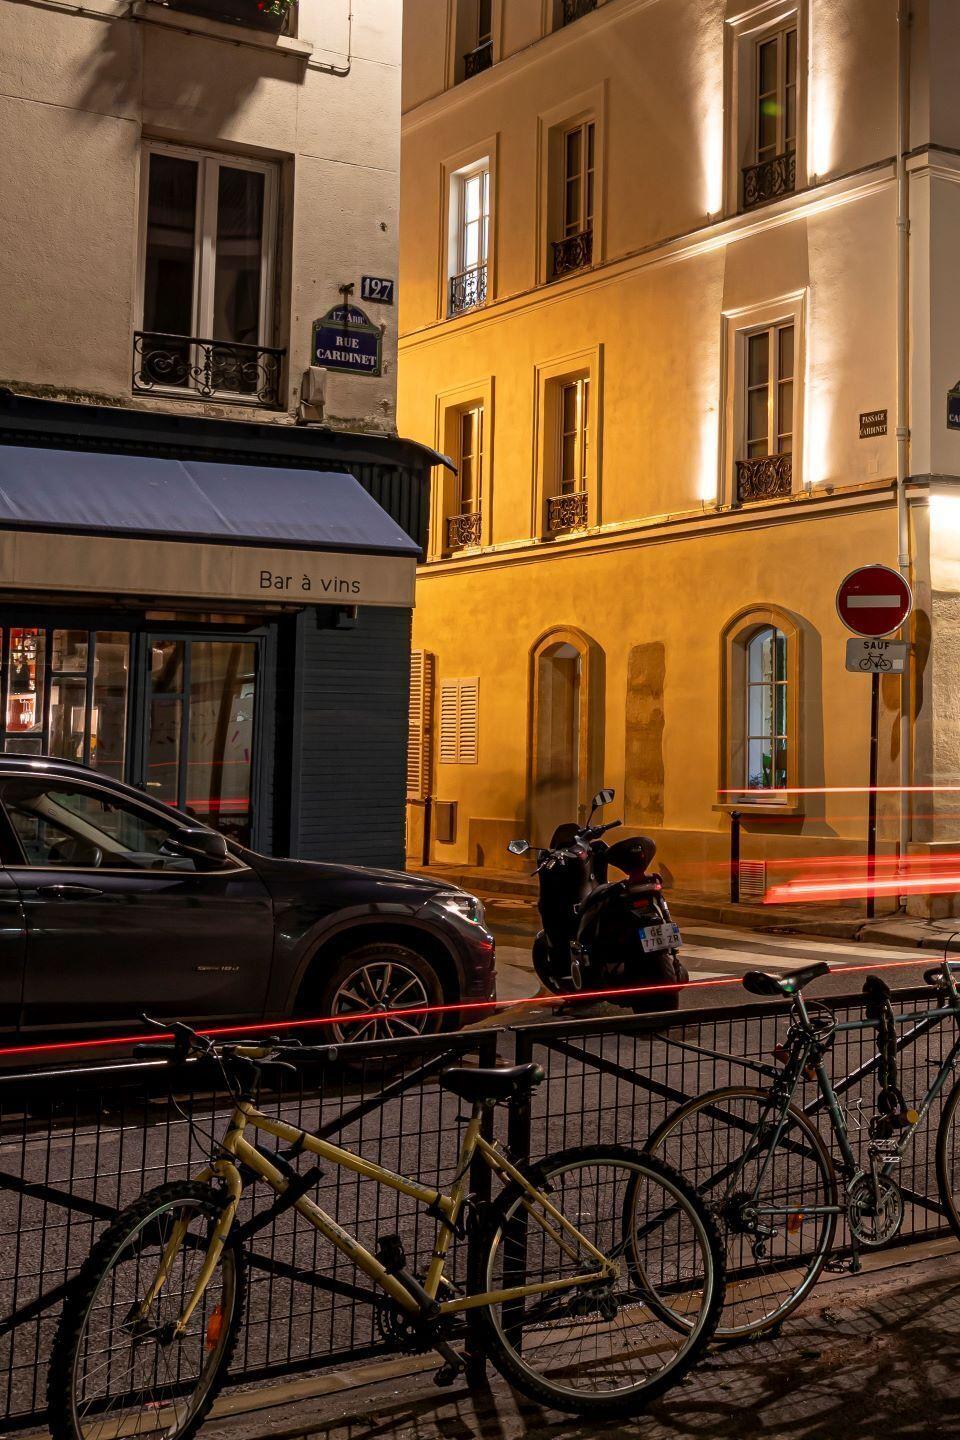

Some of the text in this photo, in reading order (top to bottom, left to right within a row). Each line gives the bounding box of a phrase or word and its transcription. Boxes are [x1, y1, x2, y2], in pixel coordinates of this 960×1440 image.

[362, 278, 392, 300] 127
[335, 335, 360, 349] RUE
[316, 348, 377, 366] CARDINET
[260, 570, 361, 594] Bar à vins
[863, 641, 890, 650] SAUF
